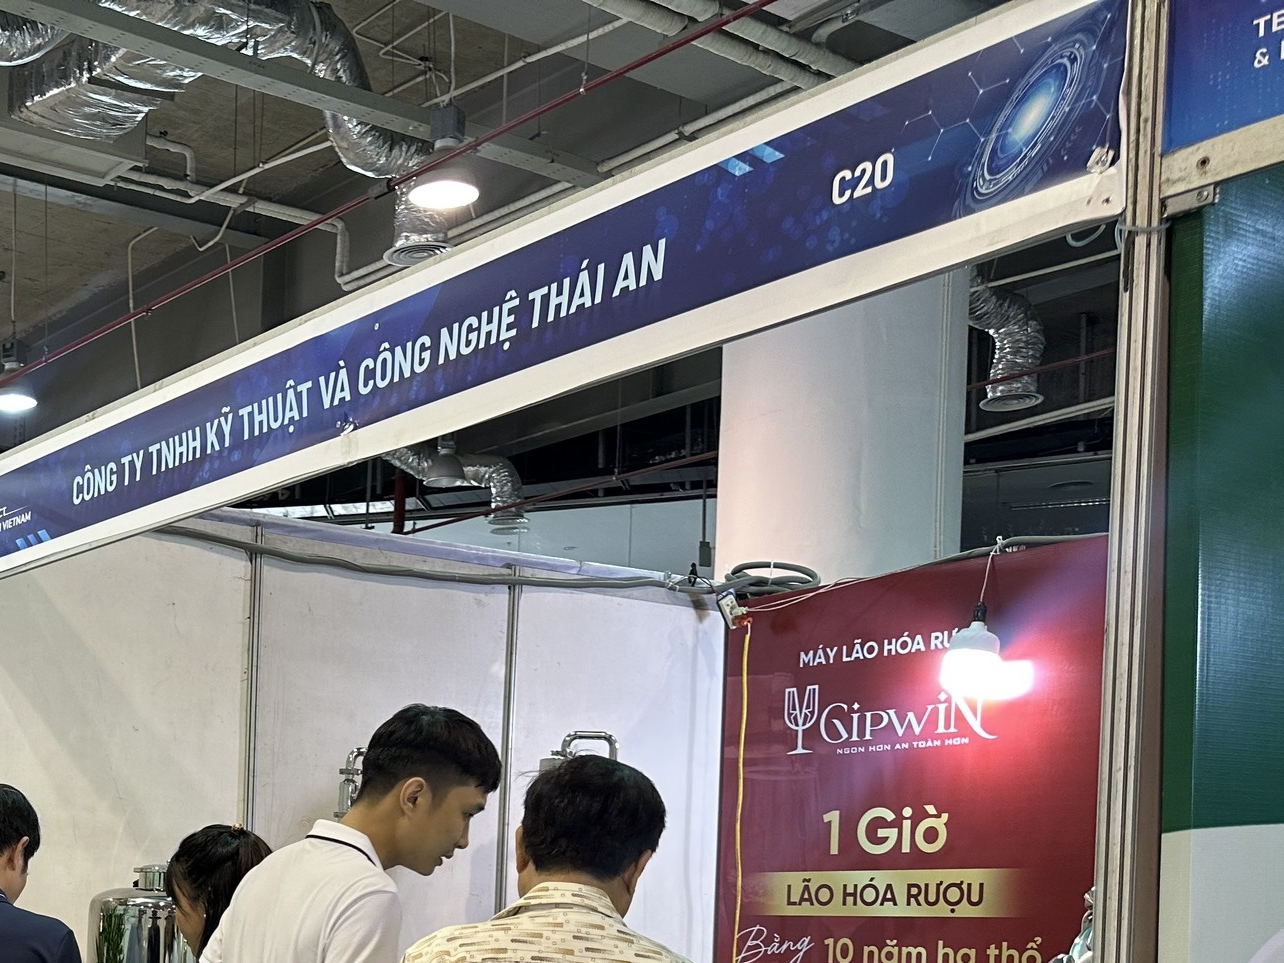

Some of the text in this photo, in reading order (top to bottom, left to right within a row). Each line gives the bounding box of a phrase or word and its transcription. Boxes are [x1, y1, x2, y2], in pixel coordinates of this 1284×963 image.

[1253, 48, 1270, 69] &
[831, 152, 895, 205] C20
[72, 237, 666, 505] CÔNG TY TNHH KỸ THUẬT VÀ CÔNG NGHỆ THÁI AN
[2, 511, 32, 531] VIETNAM
[799, 644, 838, 667] MÁY
[842, 637, 878, 662] LÃO
[883, 632, 926, 656] HÓA
[836, 736, 970, 755] NGON HƠN AN TOÀN HƠN
[822, 804, 949, 855] 1 Giờ
[786, 876, 985, 914] LÃO HÓA RƯỢU
